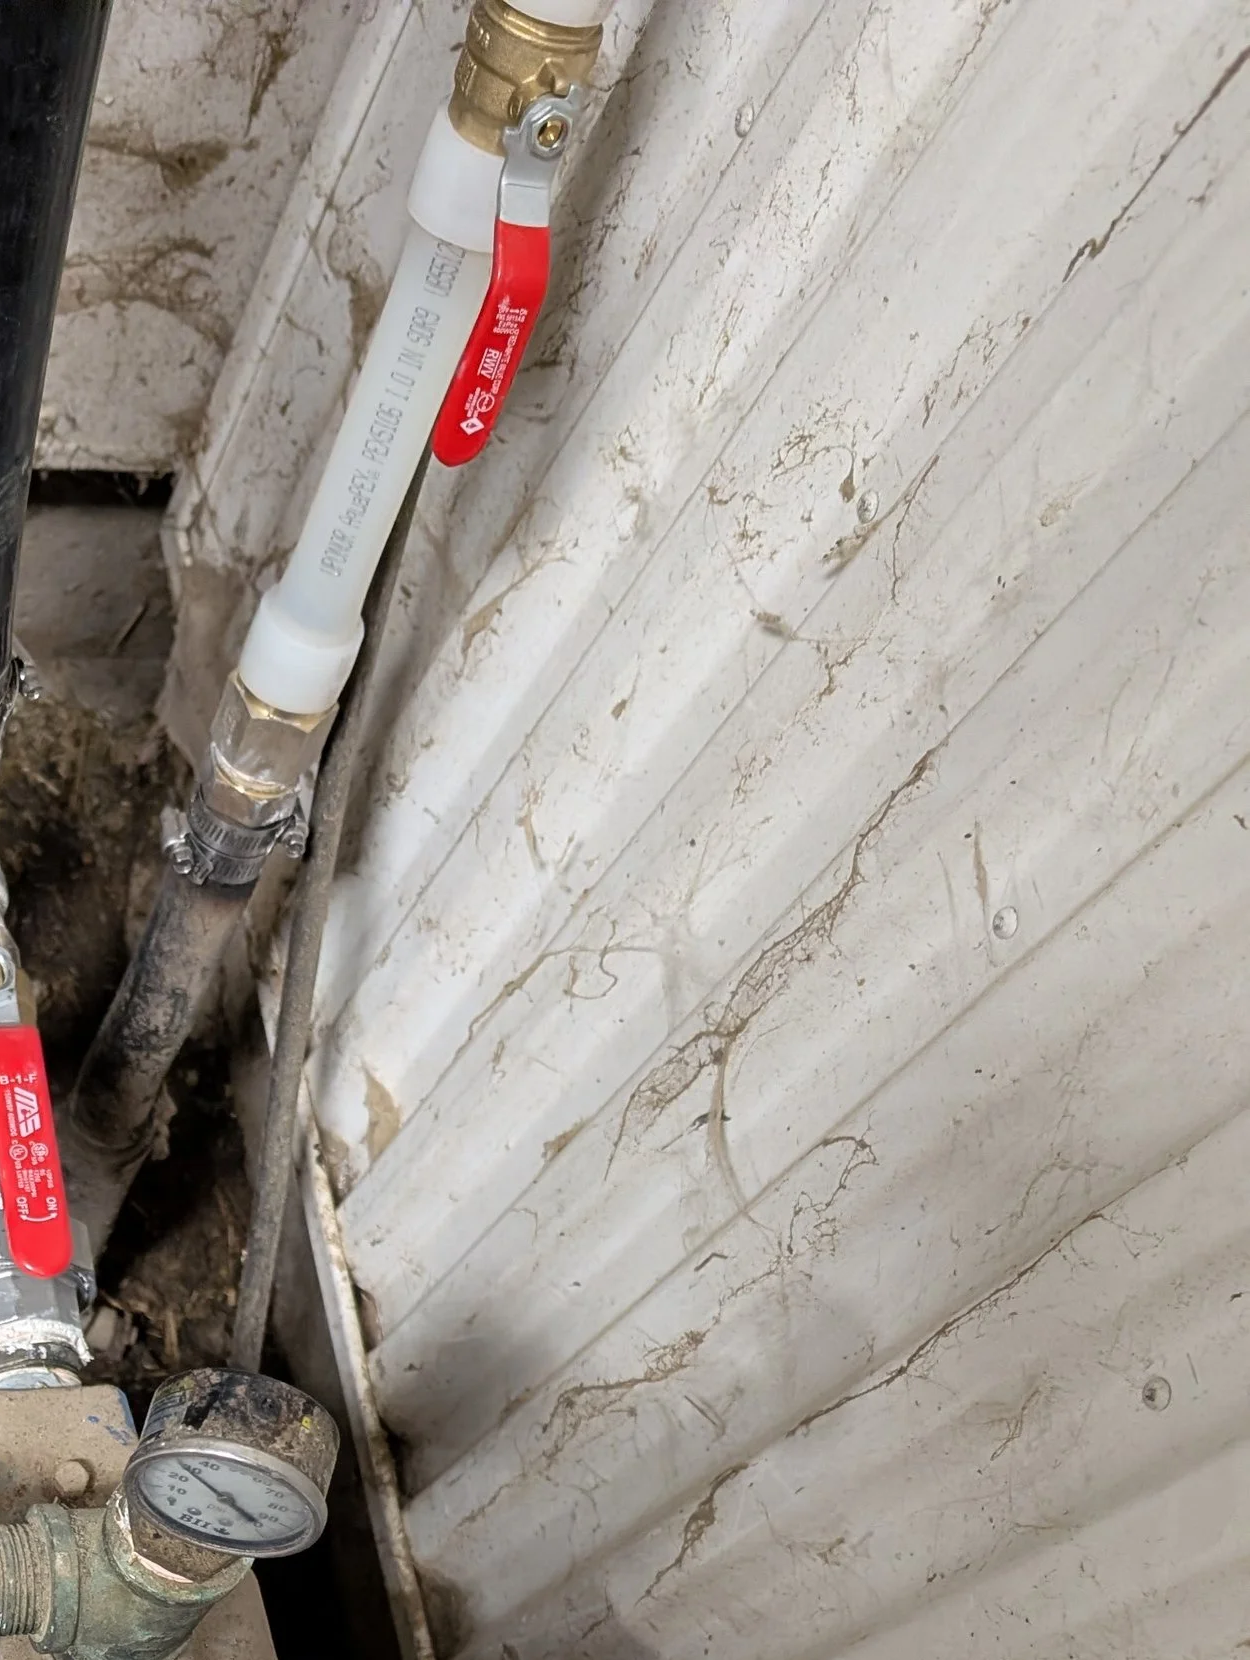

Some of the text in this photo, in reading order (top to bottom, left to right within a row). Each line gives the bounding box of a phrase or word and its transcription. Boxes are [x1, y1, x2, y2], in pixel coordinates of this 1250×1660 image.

[397, 347, 426, 371] IN
[480, 347, 498, 378] RWV
[17, 1196, 29, 1215] OFF
[46, 1196, 57, 1211] ON
[199, 1460, 221, 1471] 40
[168, 1471, 188, 1482] 20
[264, 1488, 284, 1498] 70
[267, 1503, 289, 1512] 80
